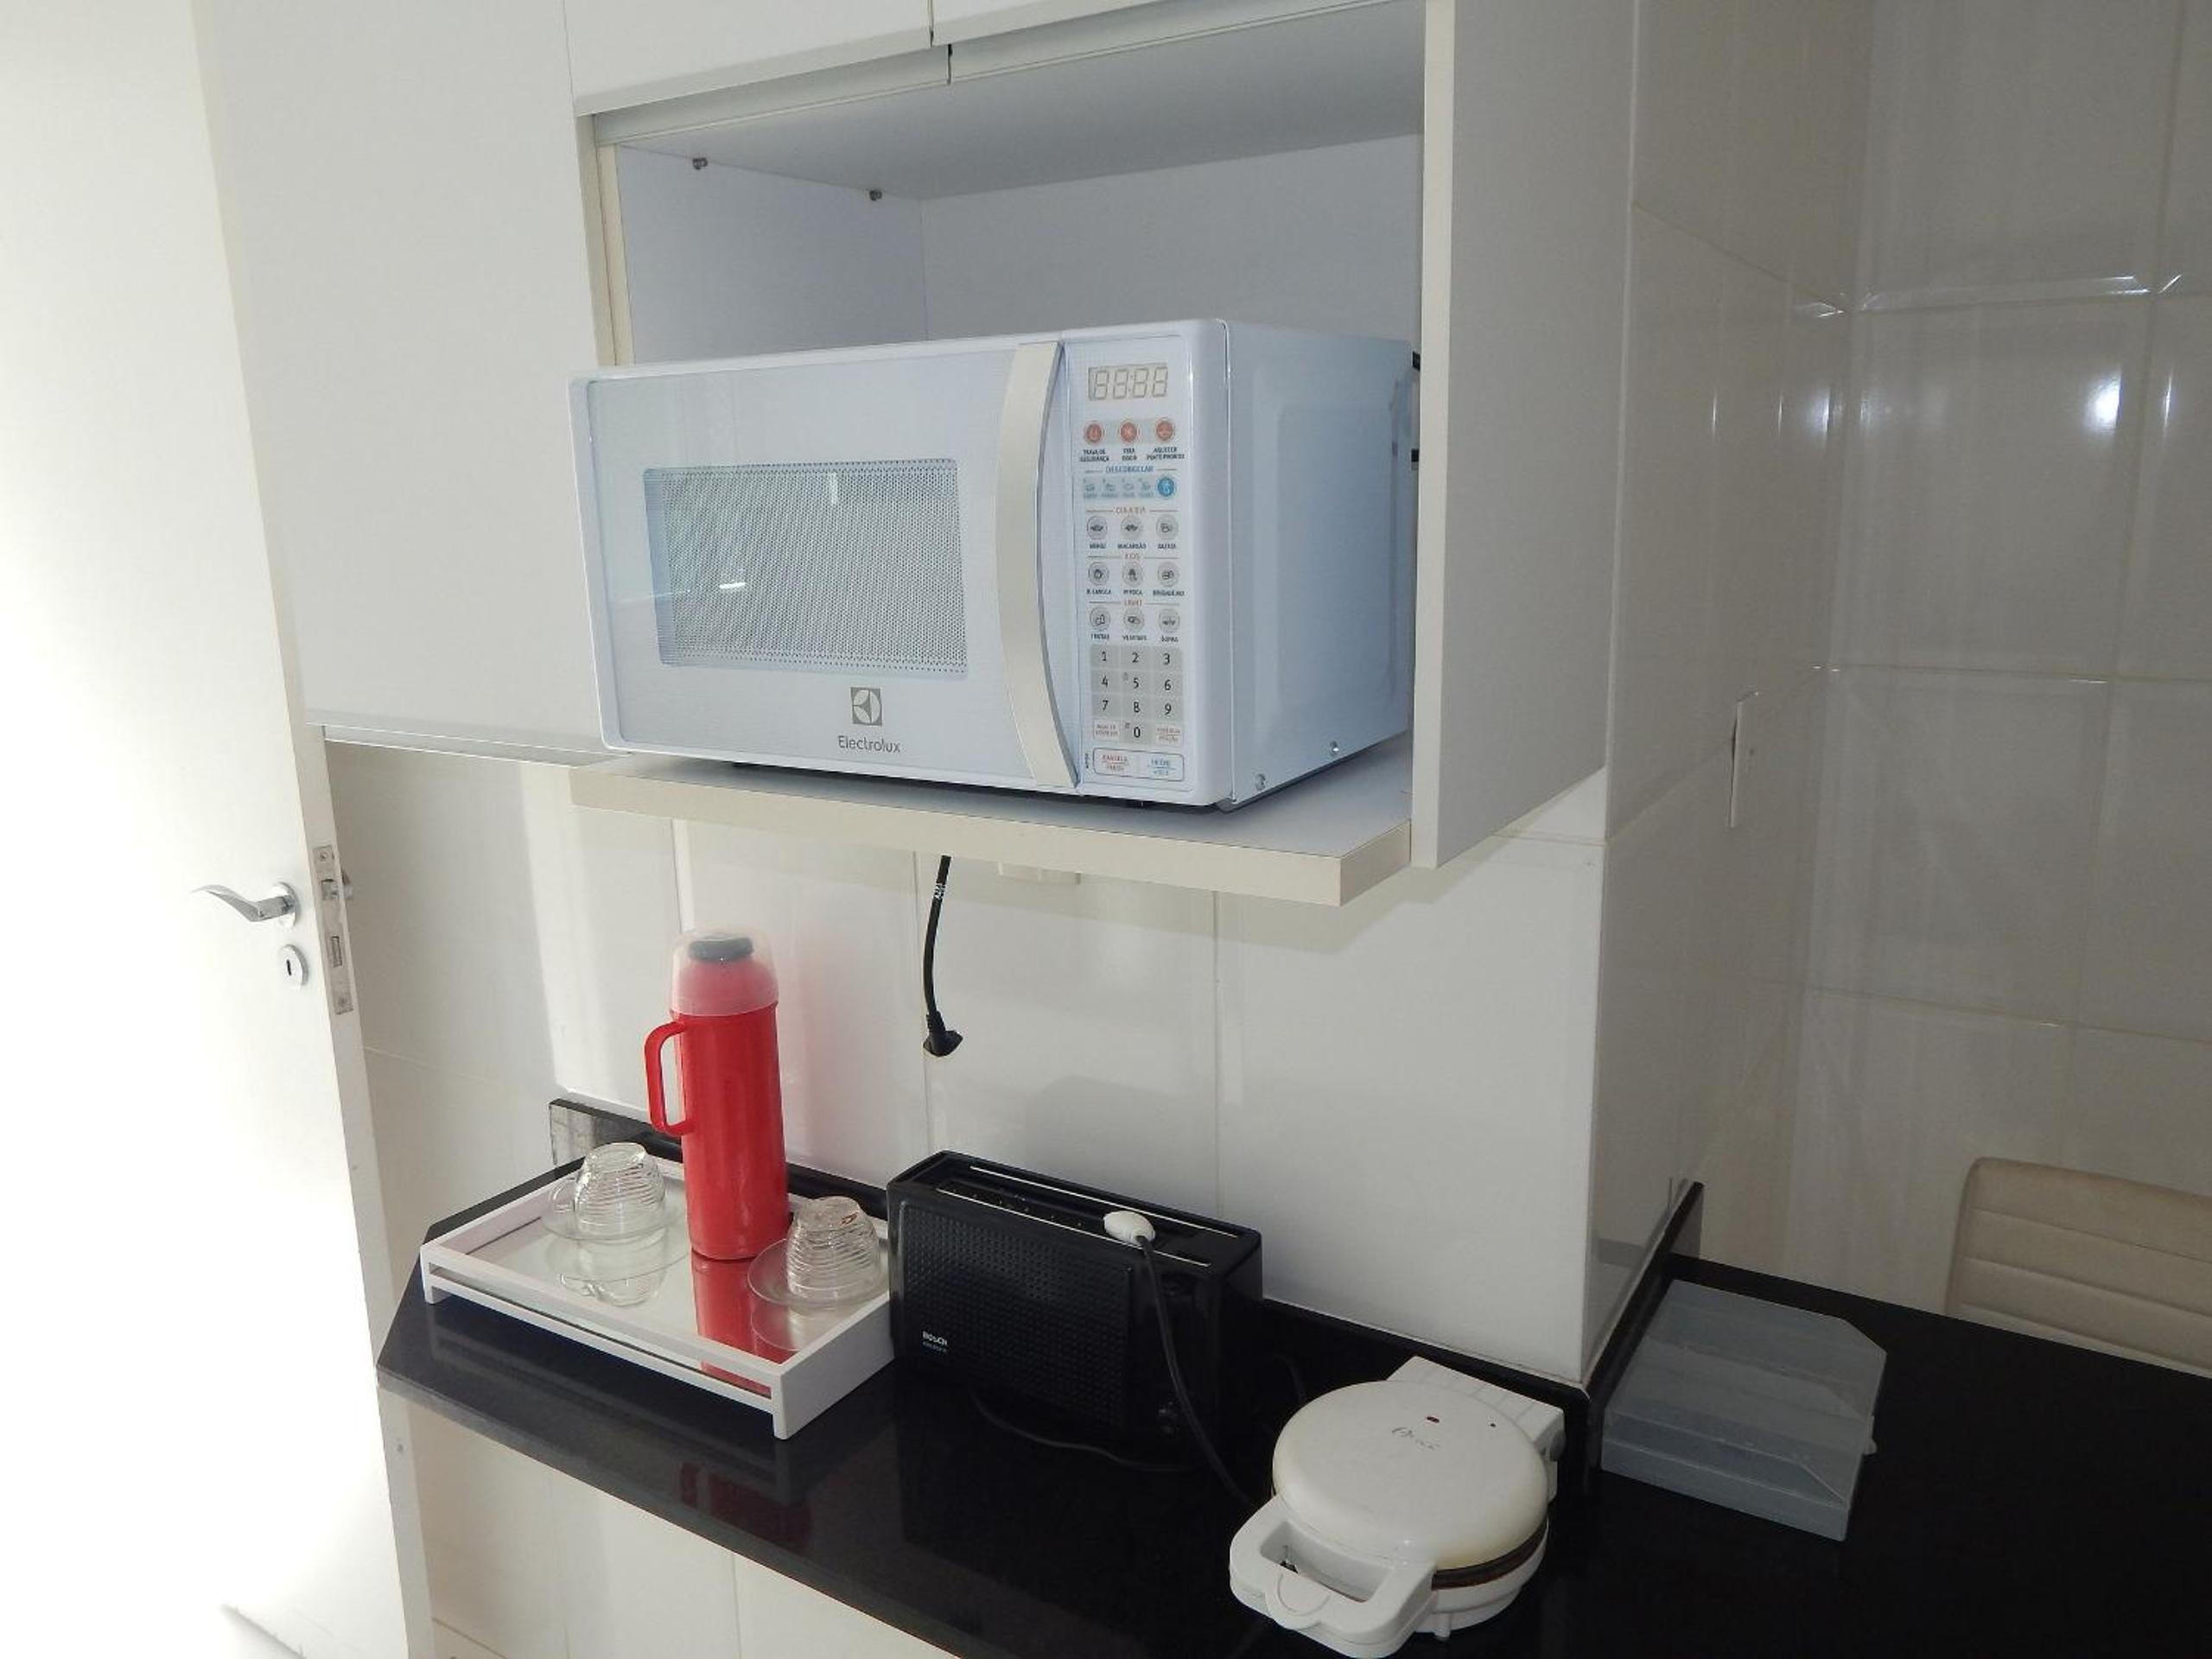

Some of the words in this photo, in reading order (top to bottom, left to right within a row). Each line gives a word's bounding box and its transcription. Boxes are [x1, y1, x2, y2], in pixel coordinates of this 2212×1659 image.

[1105, 465, 1154, 474] DESCONGELAR
[1101, 651, 1107, 662] 1
[1132, 652, 1139, 663] 2
[1162, 653, 1170, 665] 3
[1101, 676, 1109, 688] 4
[1133, 677, 1139, 689] 5
[1164, 679, 1172, 690] 6
[1102, 700, 1109, 710] 7
[1133, 702, 1141, 713] 8
[1164, 703, 1172, 715] 9
[1133, 726, 1141, 738] 0
[837, 734, 900, 753] Electrolux
